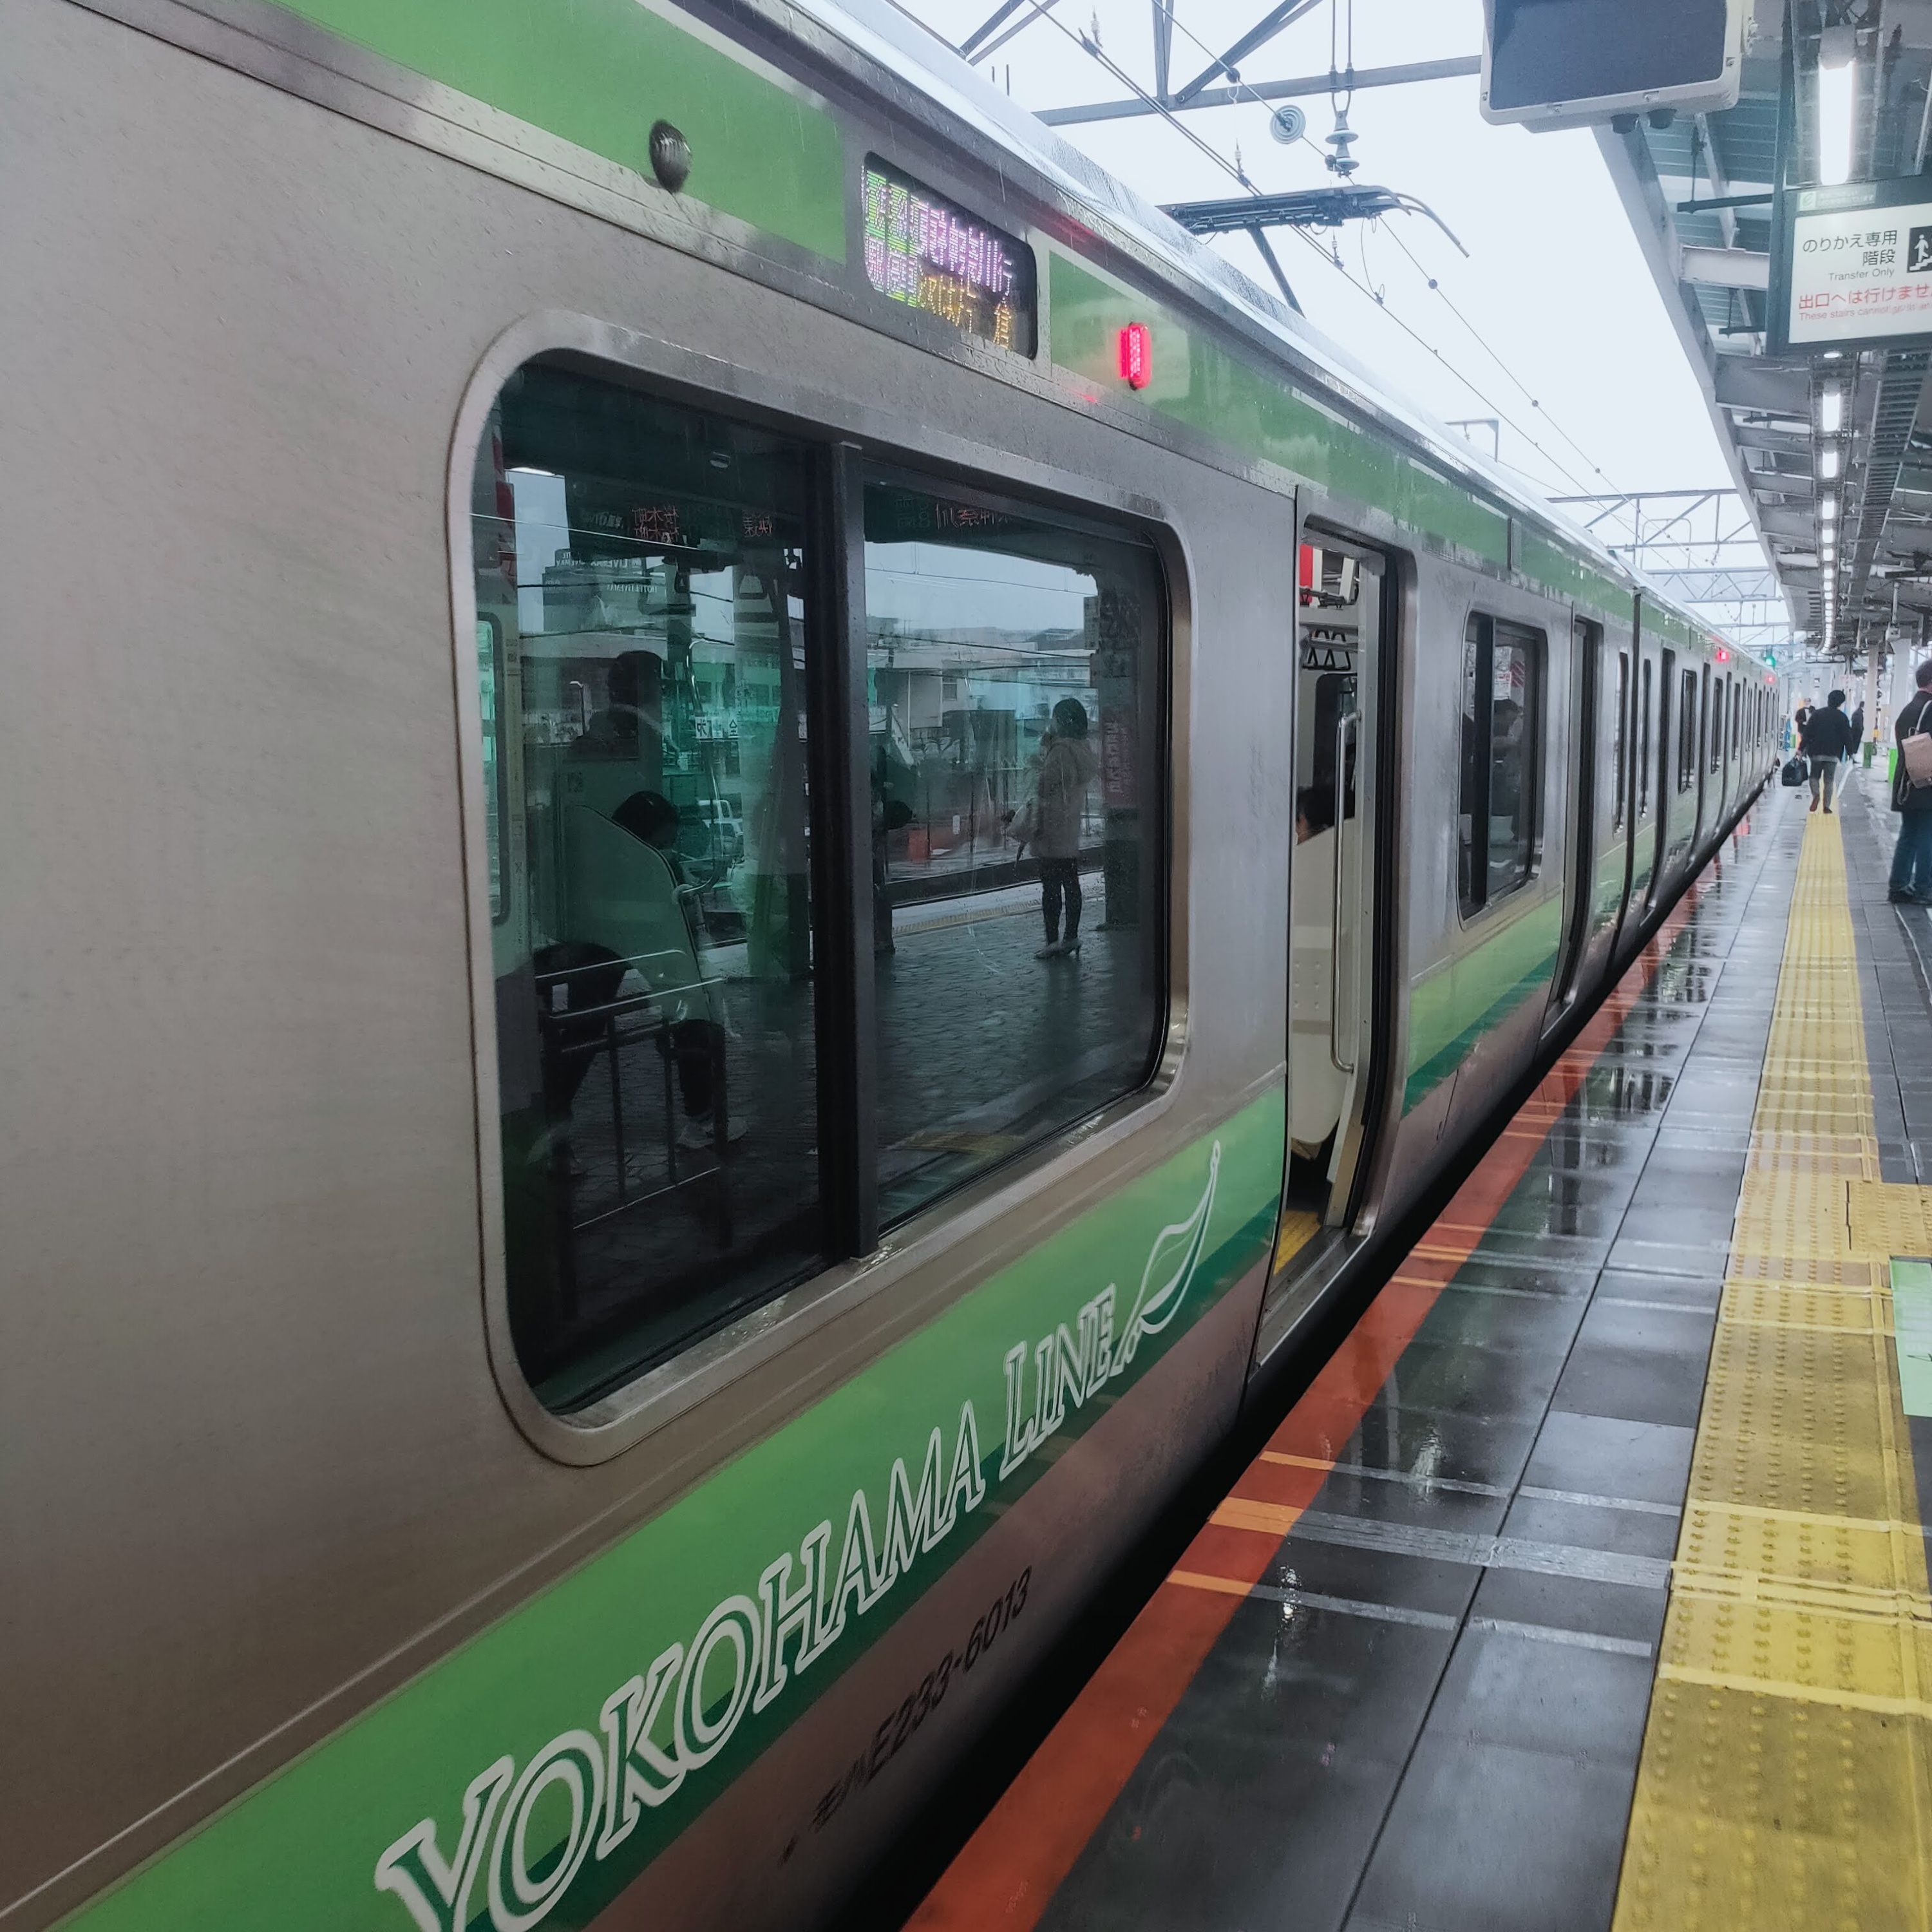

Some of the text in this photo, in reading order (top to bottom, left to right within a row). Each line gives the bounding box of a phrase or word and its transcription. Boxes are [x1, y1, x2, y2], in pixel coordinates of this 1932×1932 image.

[1803, 229, 1898, 253] のりかえ専用
[1862, 249, 1896, 267] 階段
[1828, 267, 1895, 282] Transfer Only
[1798, 283, 1932, 310] 出口へは行けませ
[1799, 312, 1828, 321] These
[374, 1282, 1117, 1932] YOKOHAMA LINE
